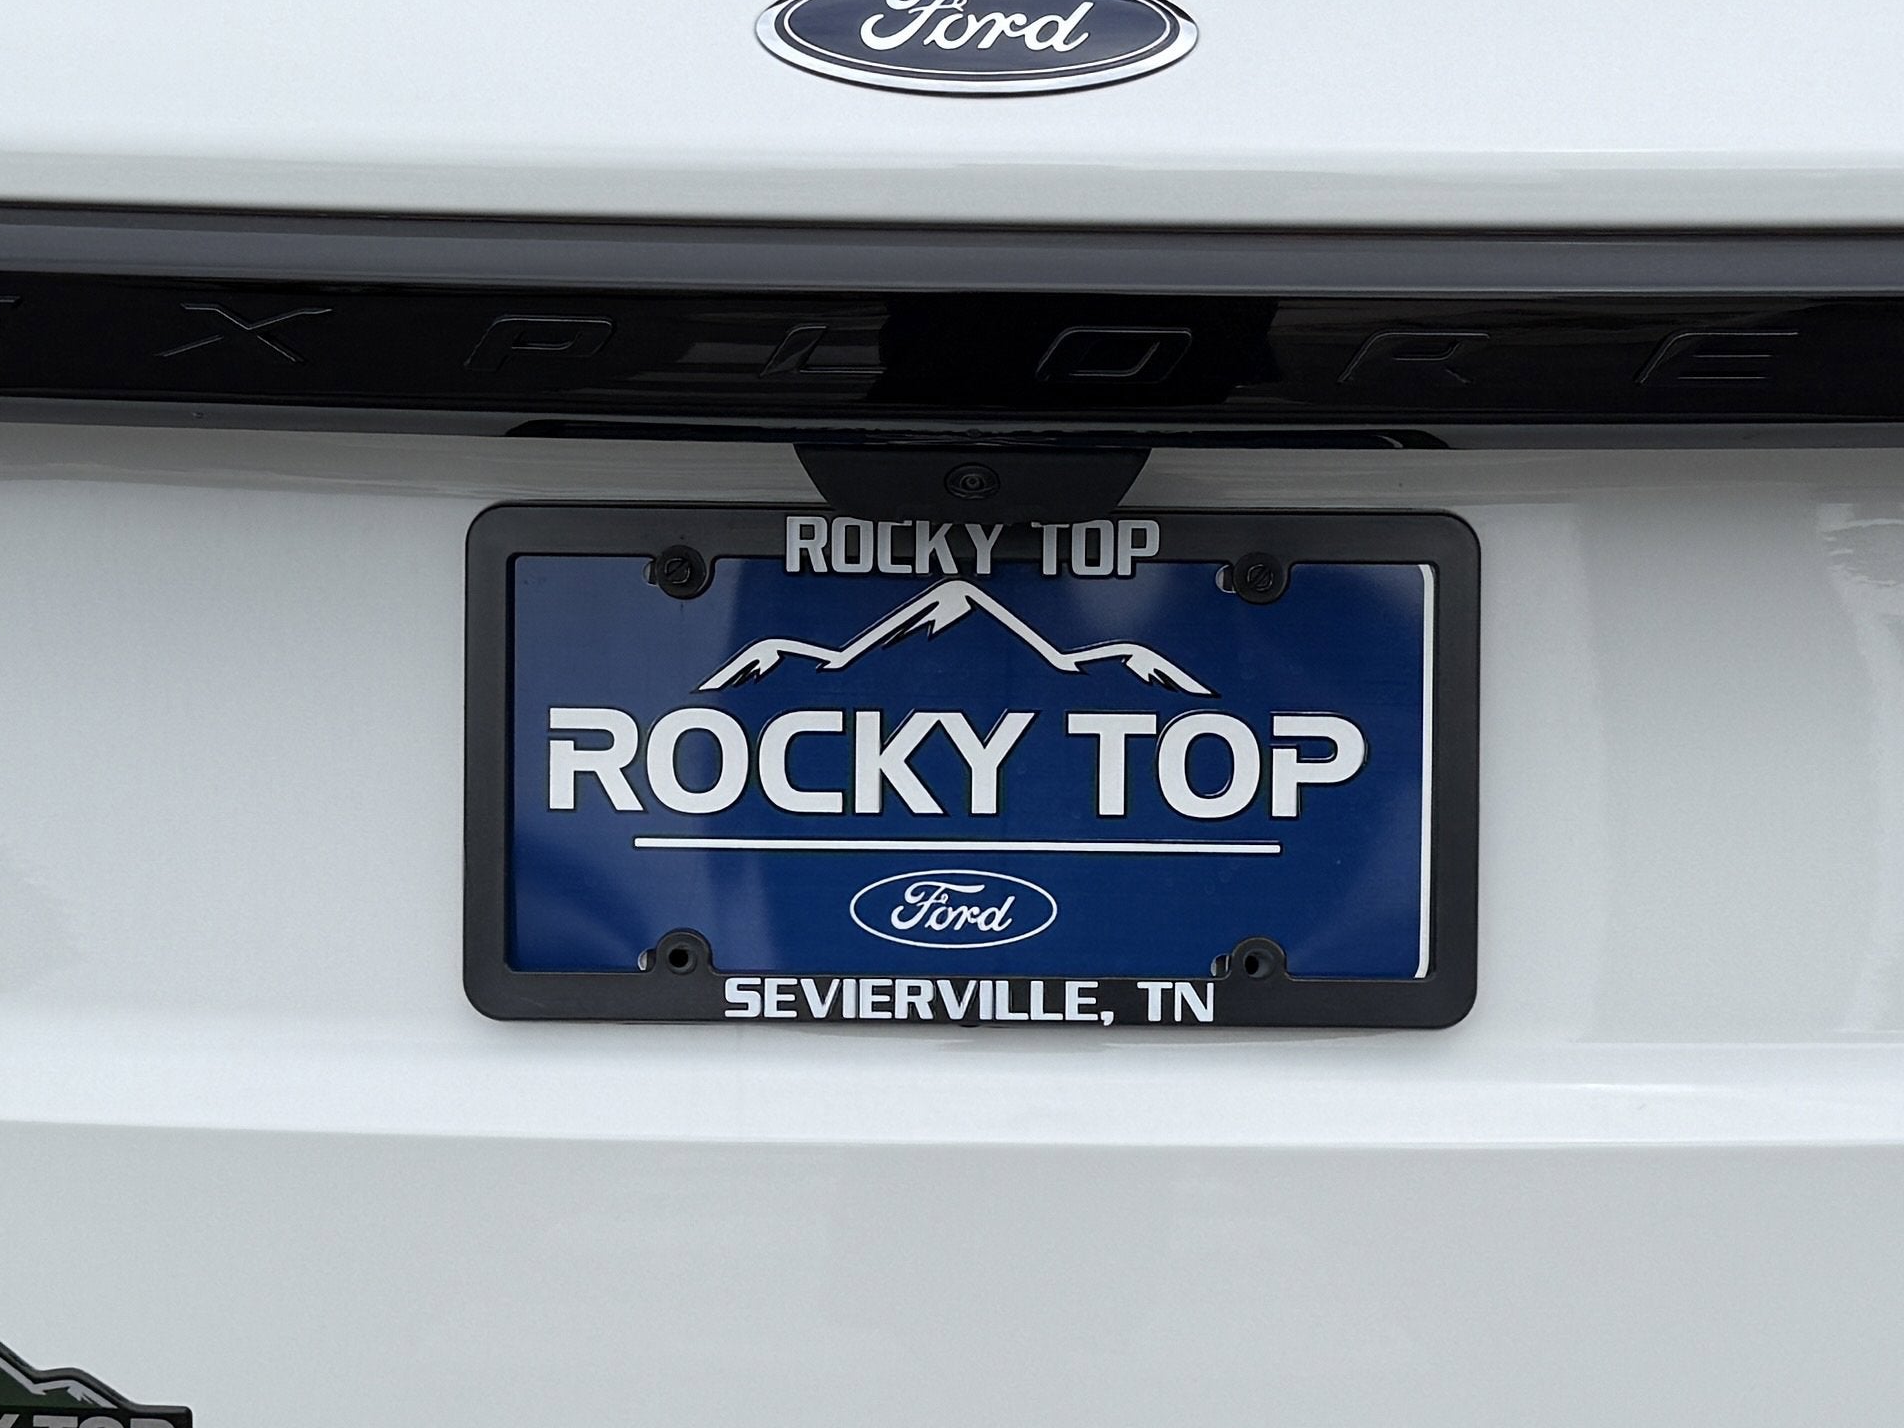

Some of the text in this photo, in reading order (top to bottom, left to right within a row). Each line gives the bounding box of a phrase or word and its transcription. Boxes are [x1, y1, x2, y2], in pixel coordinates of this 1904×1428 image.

[785, 515, 1160, 576] ROCKY TOP
[549, 707, 1364, 819] ROCKY TOP
[889, 883, 1015, 933] Ford
[723, 976, 1216, 1026] SEVIERVILLE, TN
